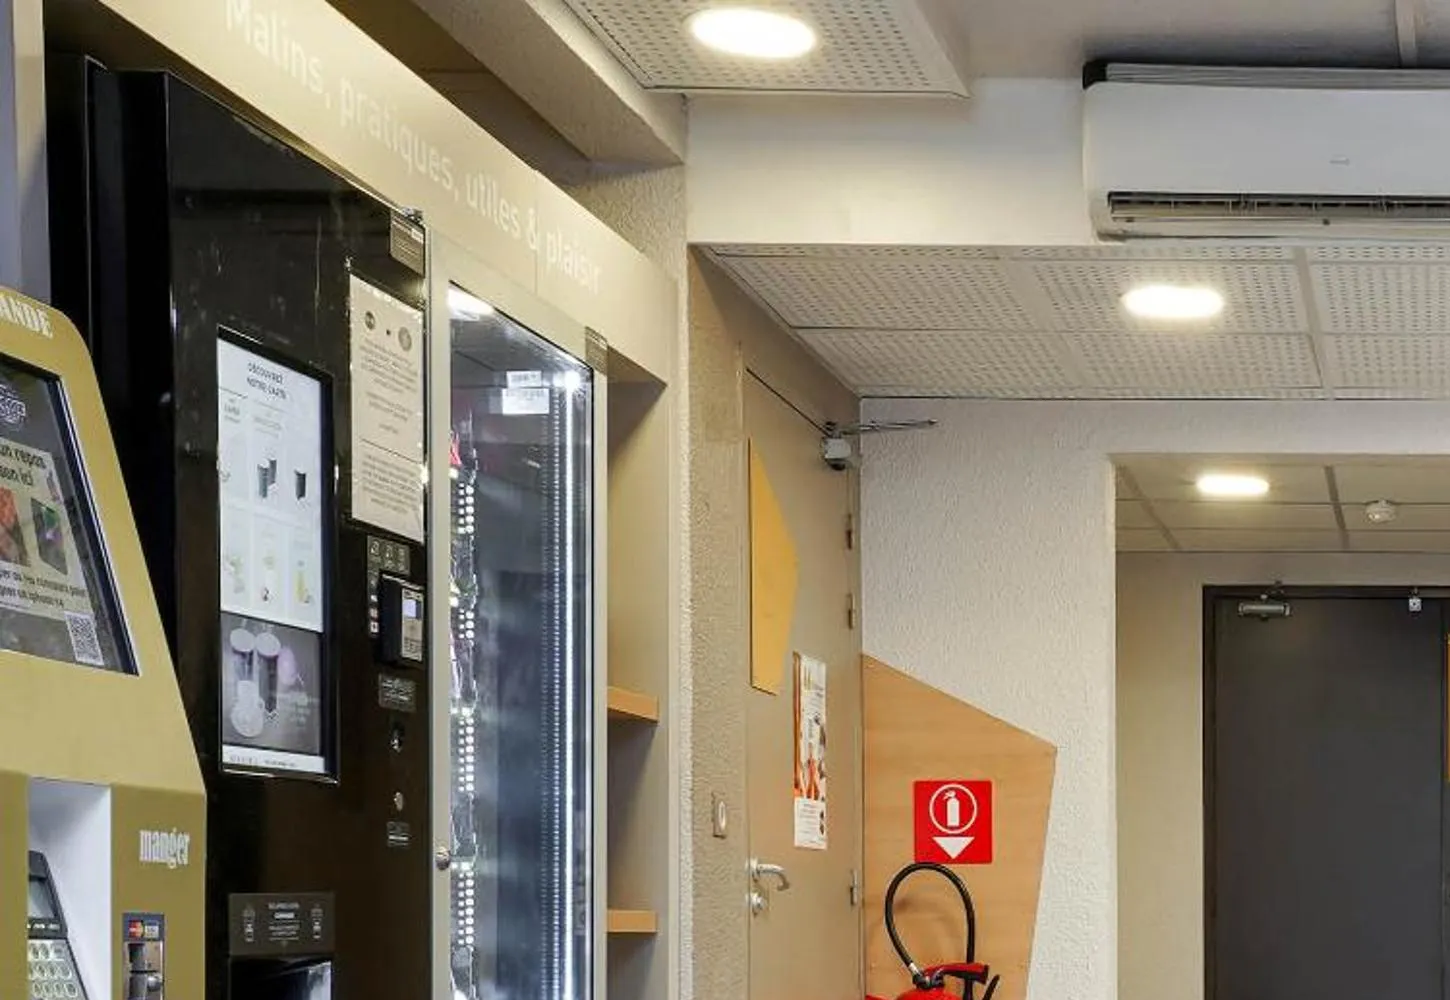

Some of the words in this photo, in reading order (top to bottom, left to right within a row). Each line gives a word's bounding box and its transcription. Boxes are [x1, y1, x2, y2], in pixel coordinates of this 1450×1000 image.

[465, 172, 522, 242] utiles
[527, 206, 541, 251] &
[546, 227, 601, 295] plaisir
[139, 828, 190, 869] manger
